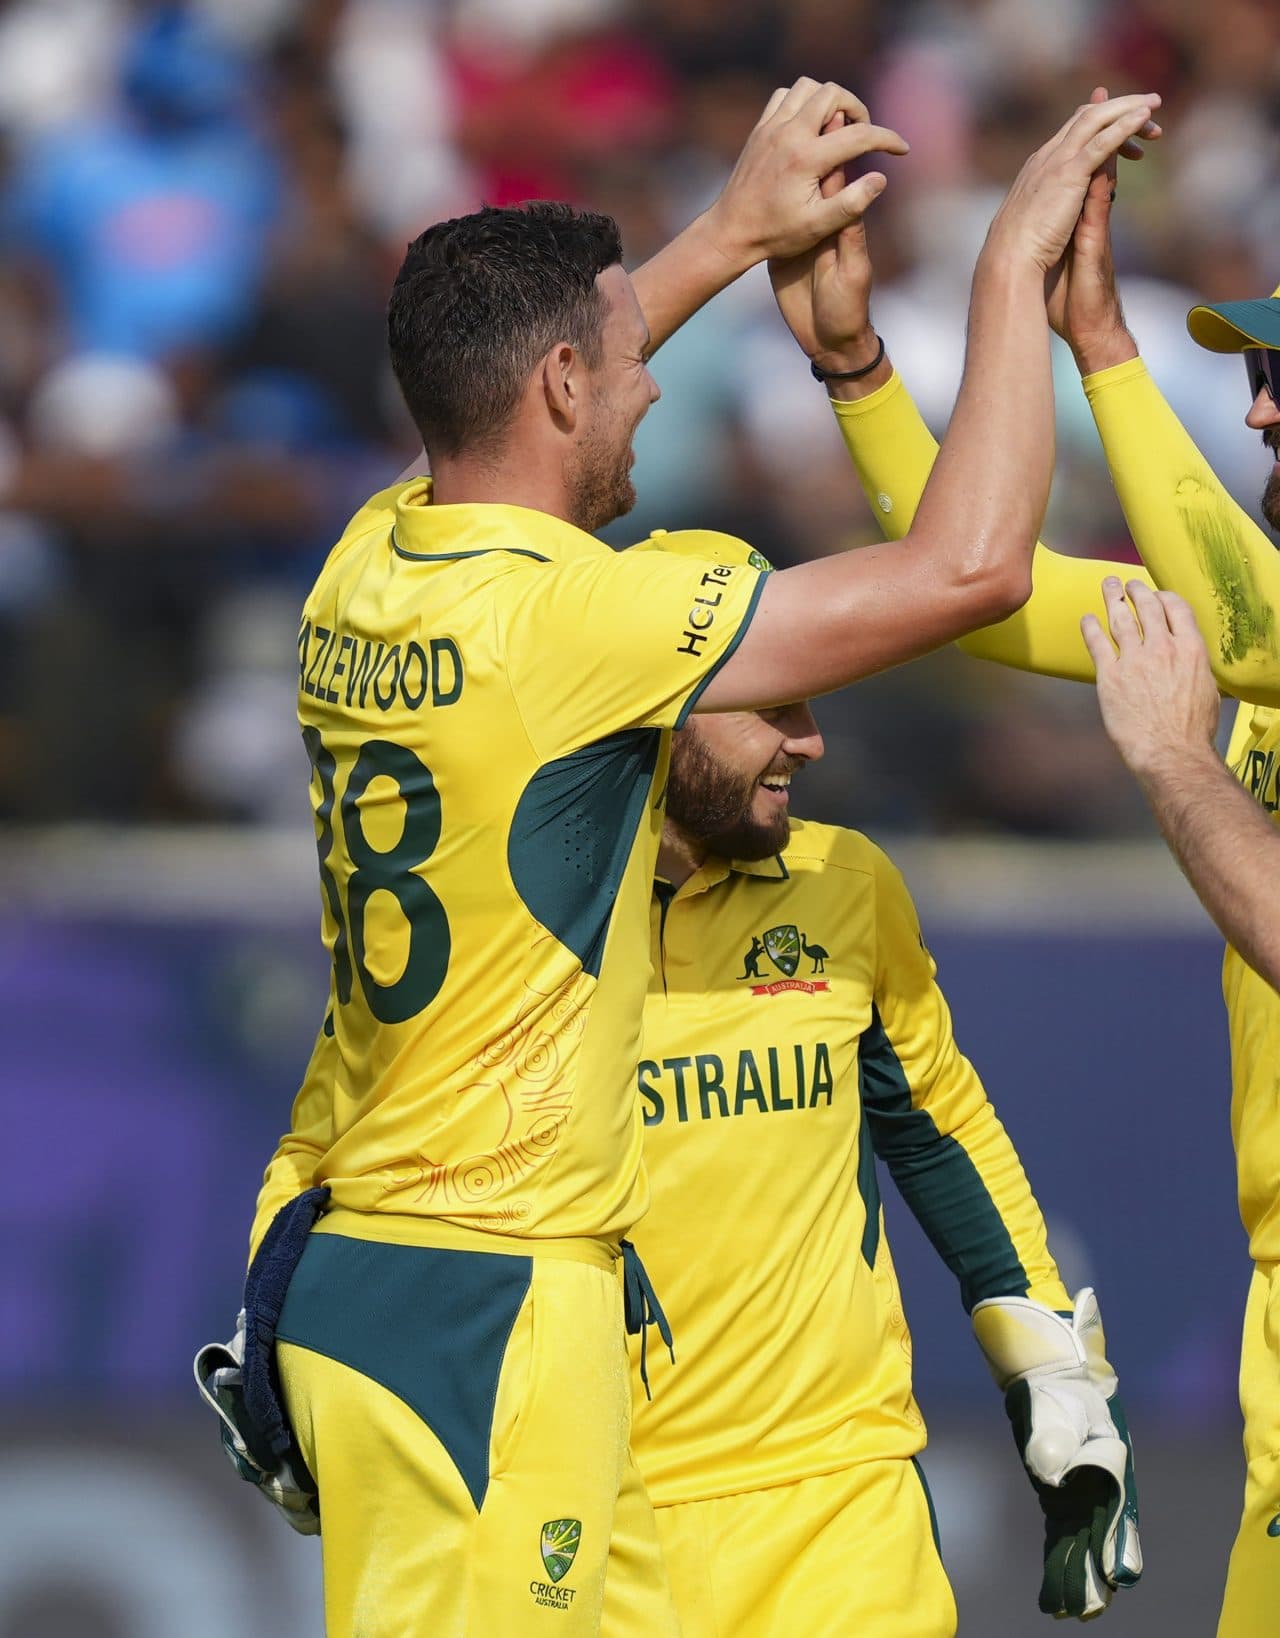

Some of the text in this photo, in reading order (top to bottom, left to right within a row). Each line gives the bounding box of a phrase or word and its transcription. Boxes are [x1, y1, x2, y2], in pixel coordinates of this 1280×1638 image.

[298, 617, 463, 711] AZLEWOOD
[771, 981, 812, 993] AUSTRALIA
[638, 1043, 833, 1127] STRALIA
[530, 1581, 576, 1602] CRICKET
[535, 1597, 568, 1610] AUSTRALIA
